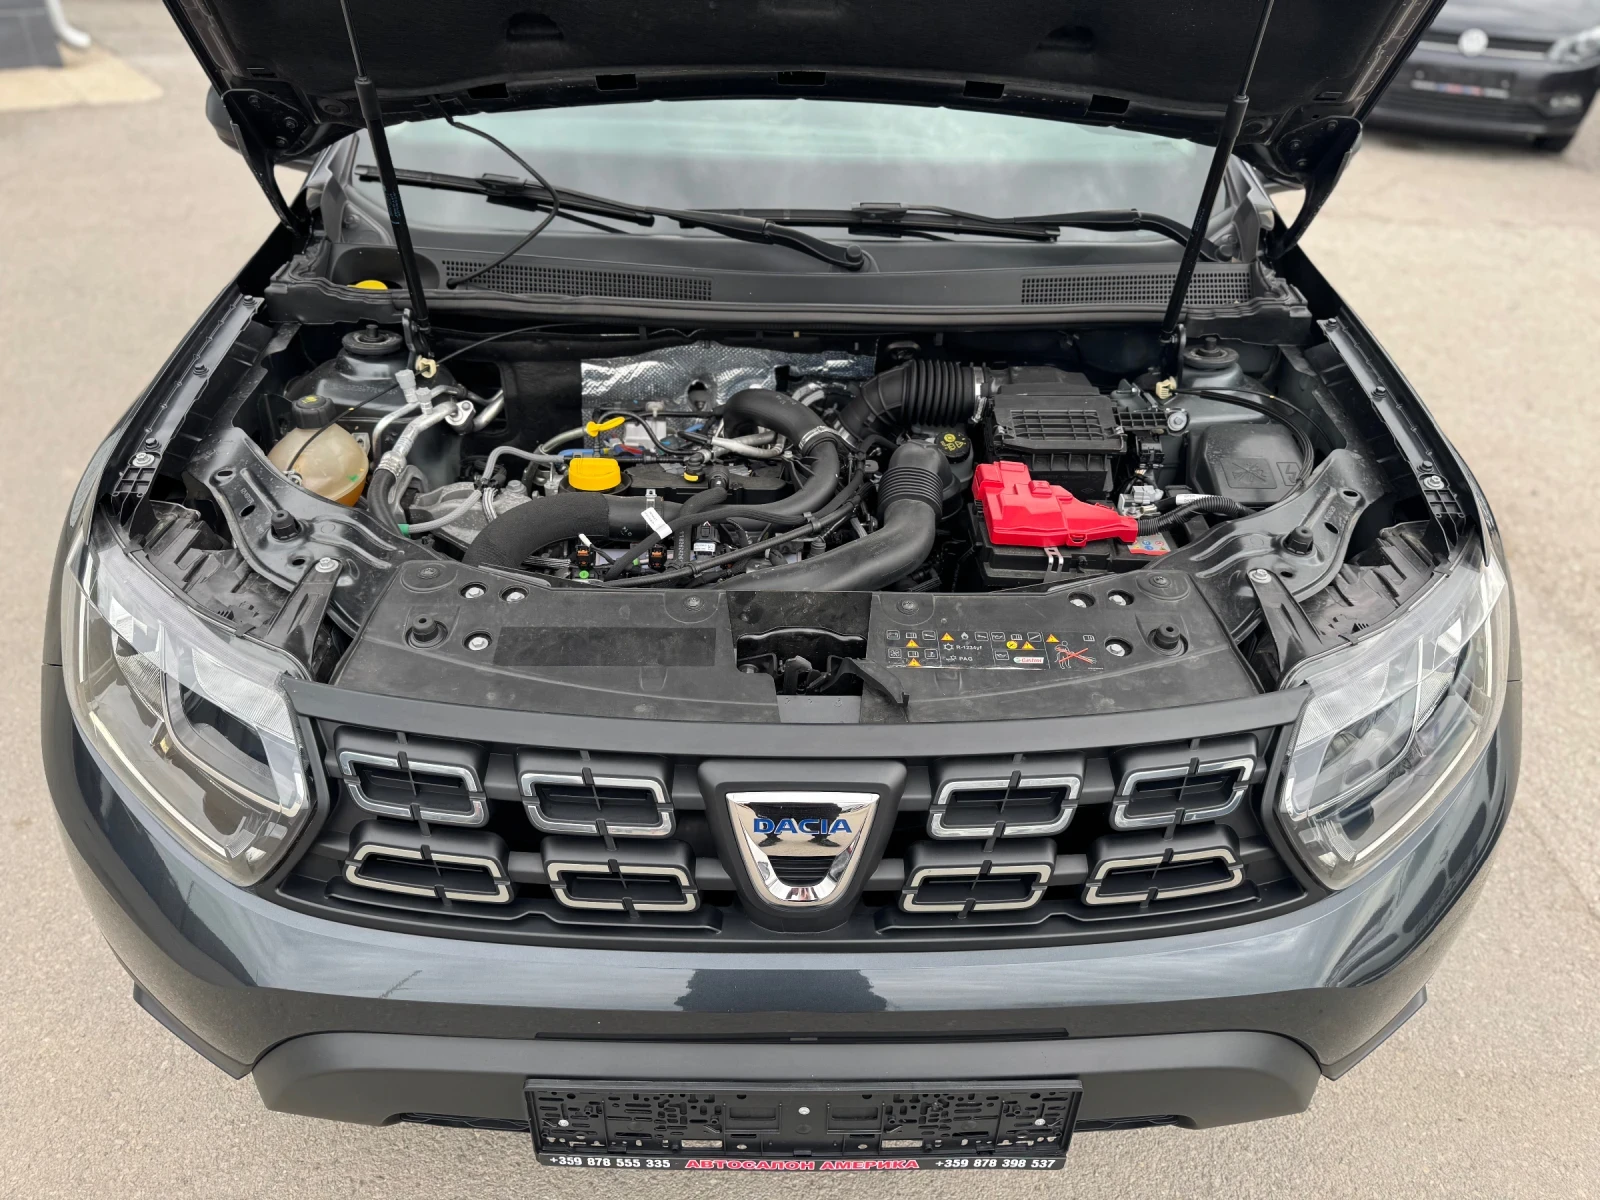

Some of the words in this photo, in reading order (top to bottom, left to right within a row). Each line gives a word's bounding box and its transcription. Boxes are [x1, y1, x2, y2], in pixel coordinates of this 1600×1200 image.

[753, 818, 852, 834] DACIA
[550, 1156, 582, 1165] +359
[587, 1158, 611, 1167] 878
[616, 1159, 640, 1168] 555
[646, 1159, 671, 1168] 335
[685, 1159, 815, 1170] АВТОСАЛОН
[819, 1159, 920, 1170] АМЕРИКА
[935, 1159, 969, 1168] +359
[973, 1159, 997, 1168] 878
[1002, 1159, 1026, 1168] 398
[1031, 1160, 1056, 1168] 537
